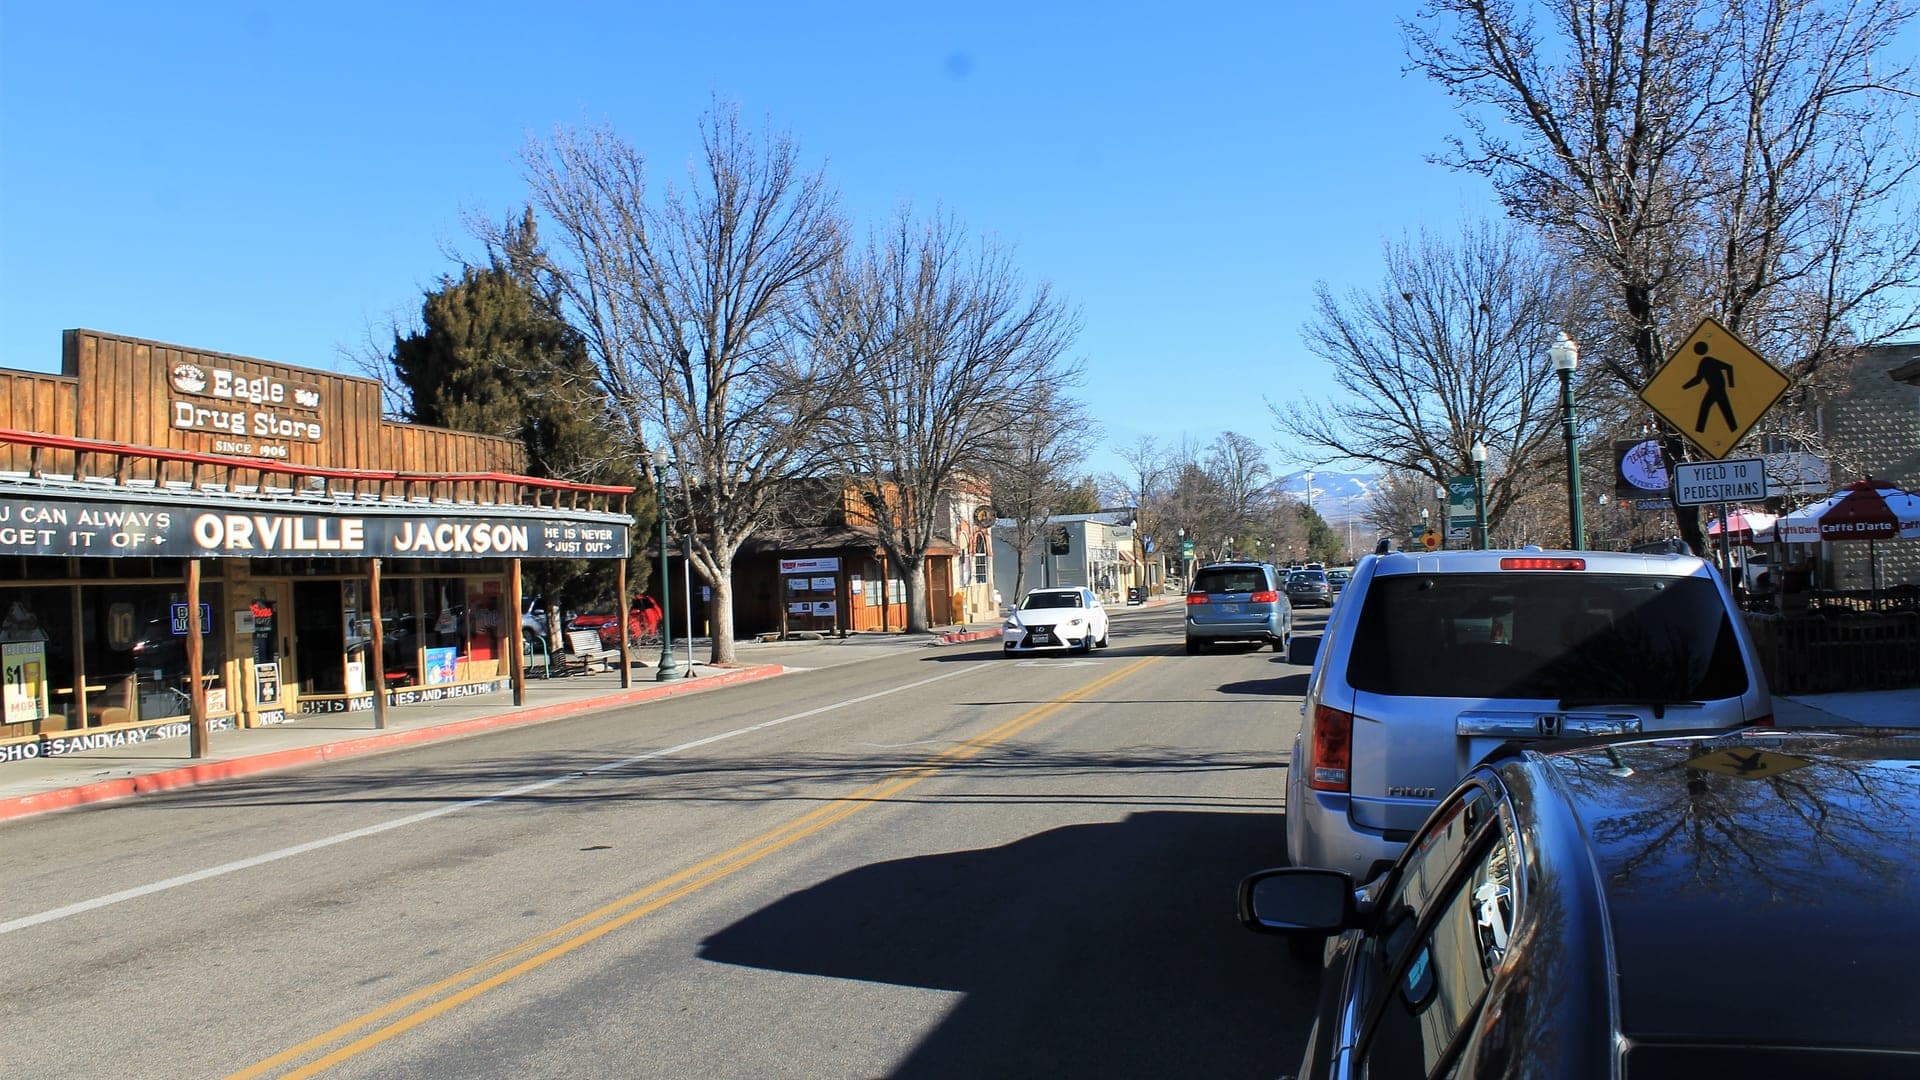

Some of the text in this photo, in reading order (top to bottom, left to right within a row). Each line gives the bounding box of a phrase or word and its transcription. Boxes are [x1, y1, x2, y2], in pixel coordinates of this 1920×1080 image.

[212, 369, 285, 404] Eagle
[174, 401, 321, 439] Drug Store
[215, 440, 286, 457] SINCE 1906
[1693, 464, 1747, 481] YIELD TO
[1683, 482, 1759, 499] PEDESTRIANS
[20, 506, 68, 526] CAN
[78, 510, 171, 528] ALWAYS
[193, 512, 364, 550] ORVILLE
[544, 527, 612, 541] HE IS NEVER
[1856, 522, 1892, 531] D'arte
[0, 528, 146, 548] GET IT OF
[394, 521, 529, 554] JACKSON
[555, 541, 604, 553] JUST OUT
[6, 665, 22, 695] $1
[11, 700, 43, 713] MORE
[301, 699, 345, 713] GIFTS
[1387, 785, 1437, 798] PILOT
